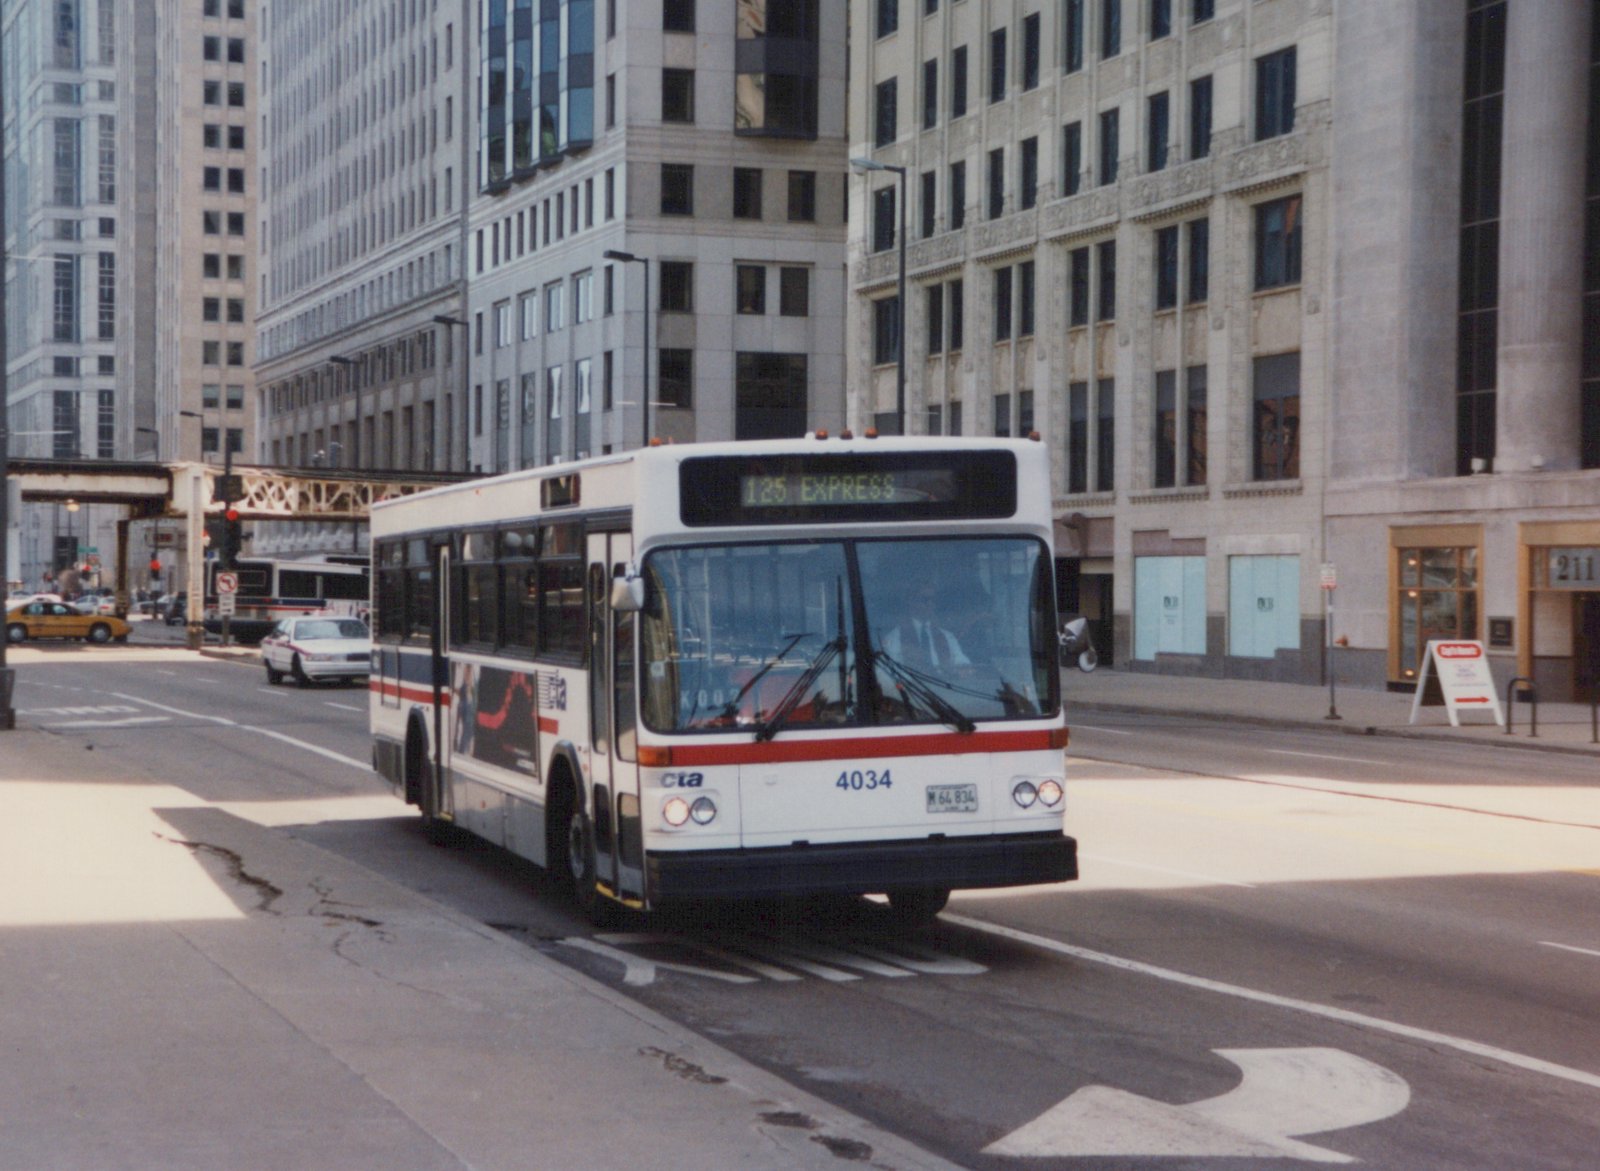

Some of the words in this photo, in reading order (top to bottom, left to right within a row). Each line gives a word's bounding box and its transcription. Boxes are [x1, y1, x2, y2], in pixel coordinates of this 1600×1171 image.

[746, 476, 787, 504] 125
[800, 474, 896, 502] EXPRESS
[1557, 555, 1595, 581] 211
[660, 771, 704, 788] cta
[836, 769, 893, 791] 4034
